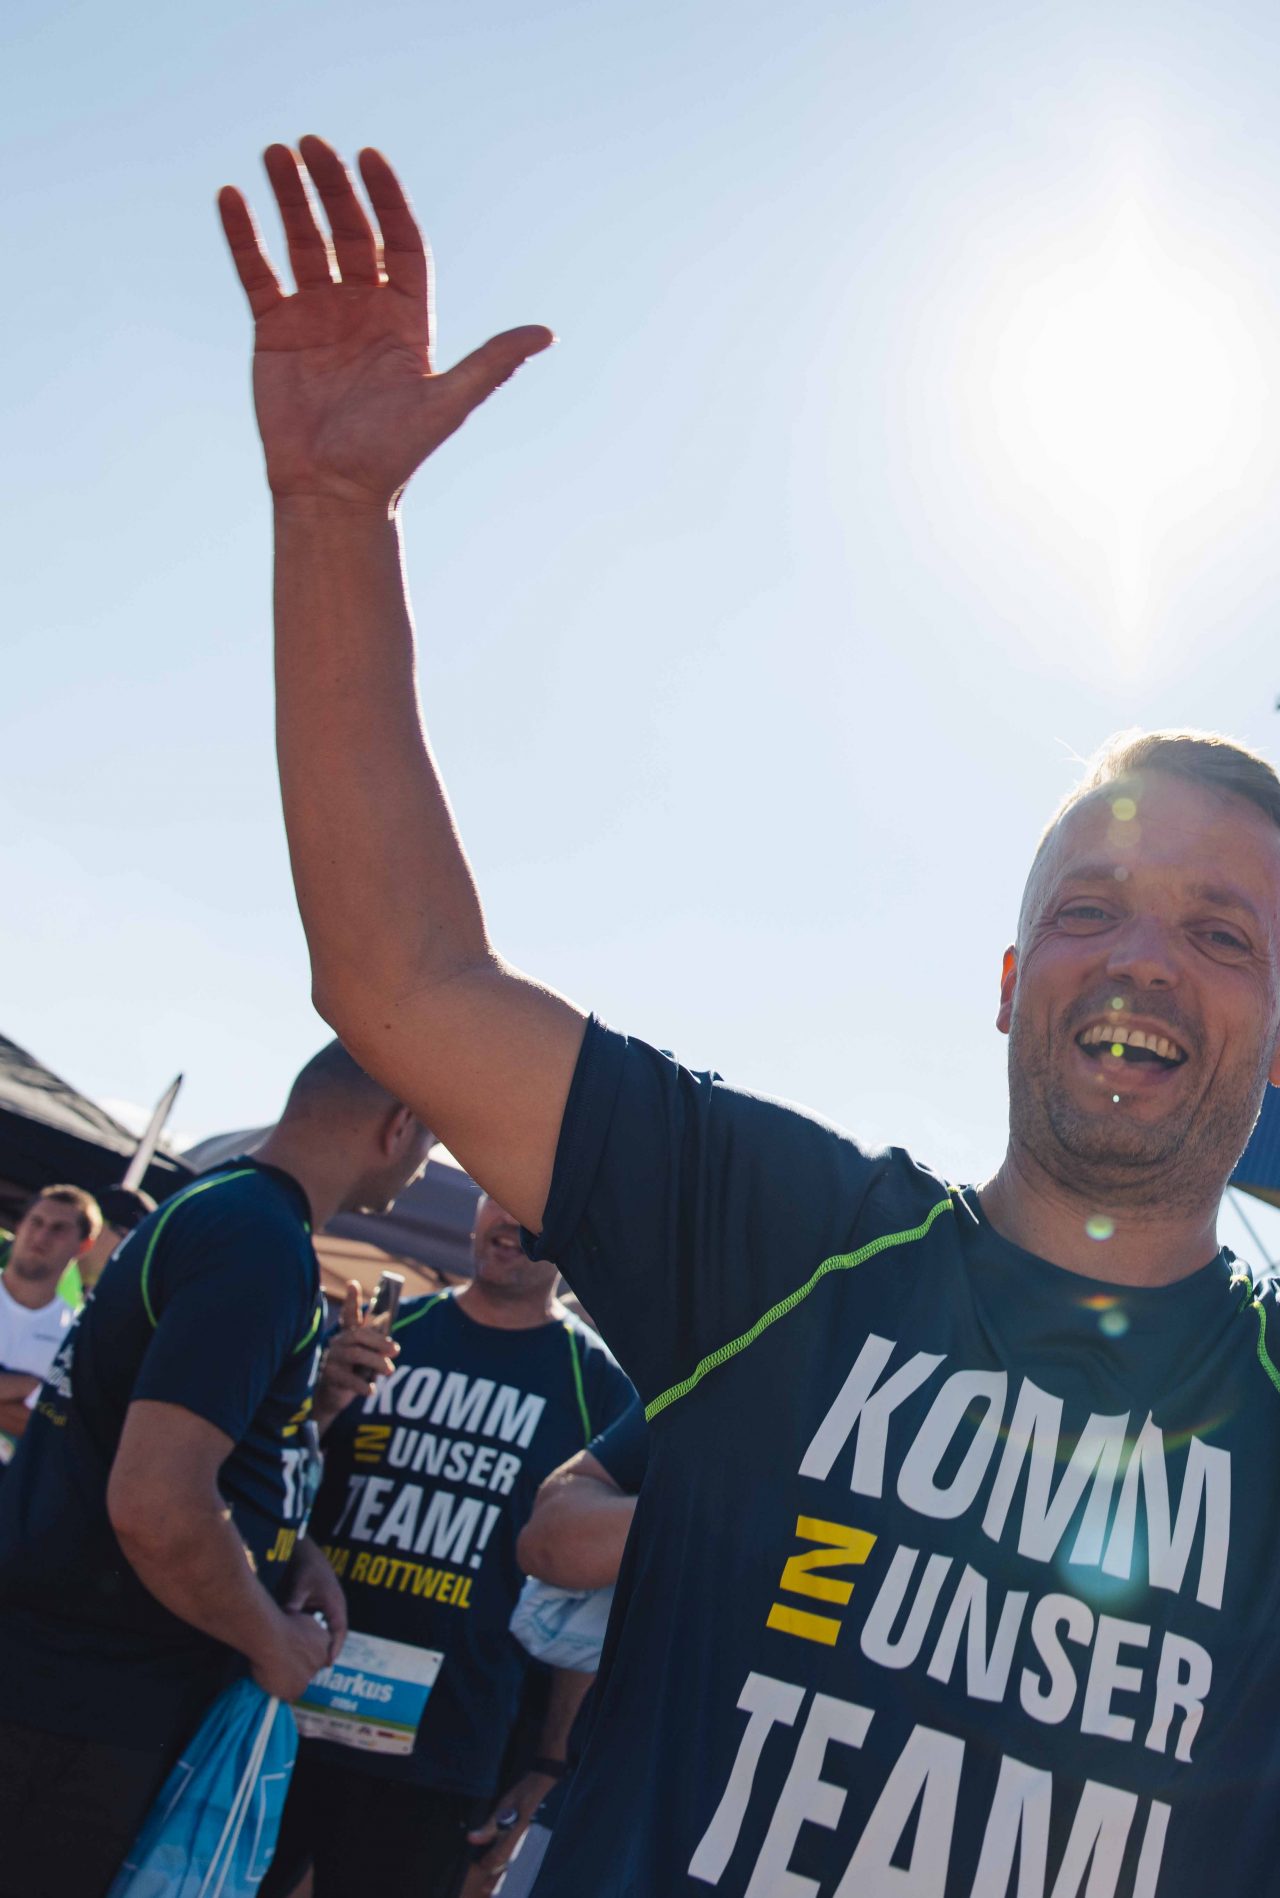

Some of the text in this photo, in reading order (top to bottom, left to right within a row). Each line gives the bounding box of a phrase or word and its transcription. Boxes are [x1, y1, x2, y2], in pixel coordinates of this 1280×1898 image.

[362, 1364, 547, 1448] KOMM
[354, 1424, 522, 1496] IN UNSER
[798, 1333, 1231, 1611] KOMM
[332, 1474, 501, 1570] TEAM!
[350, 1552, 474, 1609] ROTTWEIL
[766, 1514, 1214, 1764] IN UNSER
